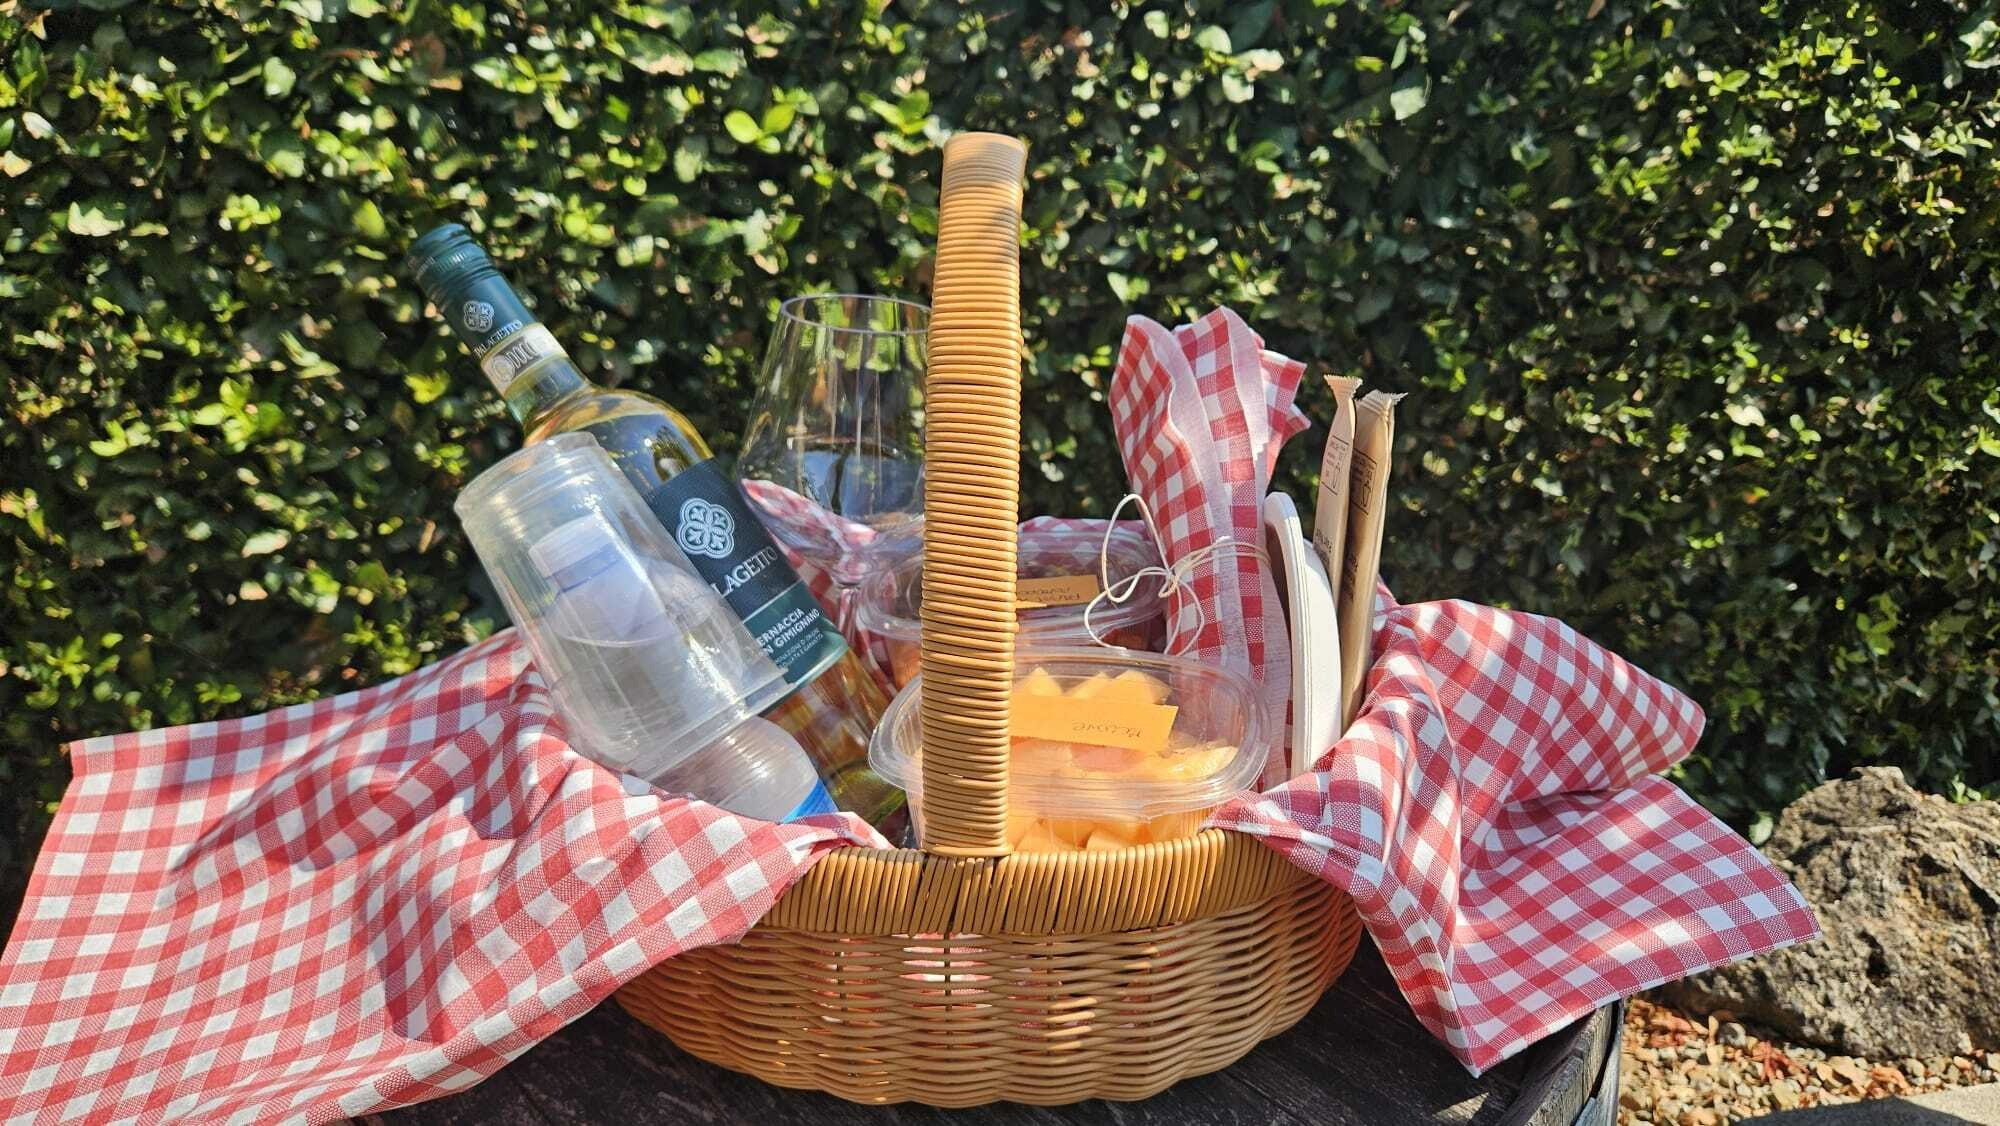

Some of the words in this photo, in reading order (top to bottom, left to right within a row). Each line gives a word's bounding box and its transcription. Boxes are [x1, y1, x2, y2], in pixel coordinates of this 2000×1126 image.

[712, 546, 778, 598] LAGETTO
[757, 607, 805, 646] ERNACCIA
[775, 608, 820, 649] GIMIGNANO
